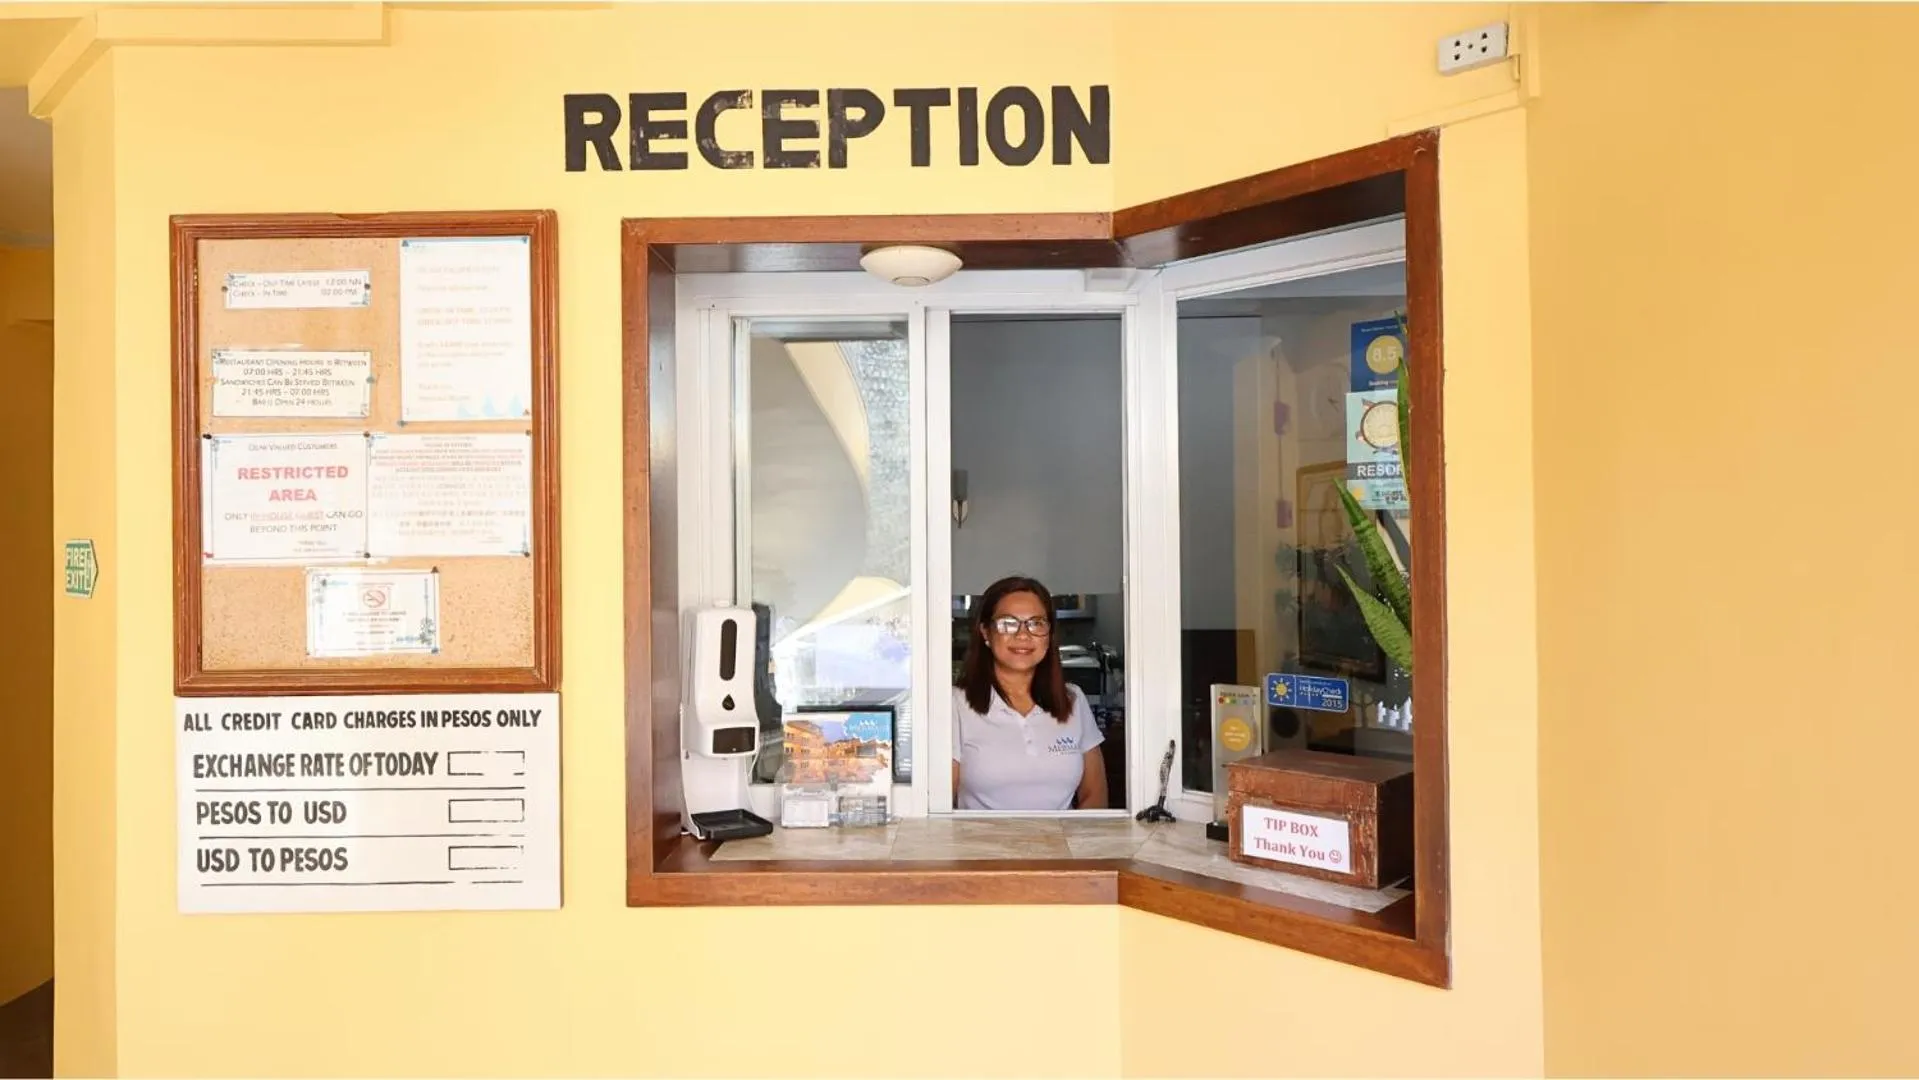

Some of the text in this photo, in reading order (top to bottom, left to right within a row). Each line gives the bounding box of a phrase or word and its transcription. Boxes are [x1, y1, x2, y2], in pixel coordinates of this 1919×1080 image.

[564, 85, 1111, 171] RECEPTION
[237, 465, 349, 480] RESTRICTED
[268, 488, 318, 502] AREA
[183, 708, 542, 732] ALL CREDIT CARD CHARGES IN PESOS ONLY
[193, 750, 439, 779] EXCHANGE RATE OF TODAY
[196, 800, 347, 825] PESOS TO USD
[1264, 817, 1319, 838] TIP BOX
[196, 846, 348, 873] USD TO PESOS
[1253, 836, 1325, 861] Thank You
